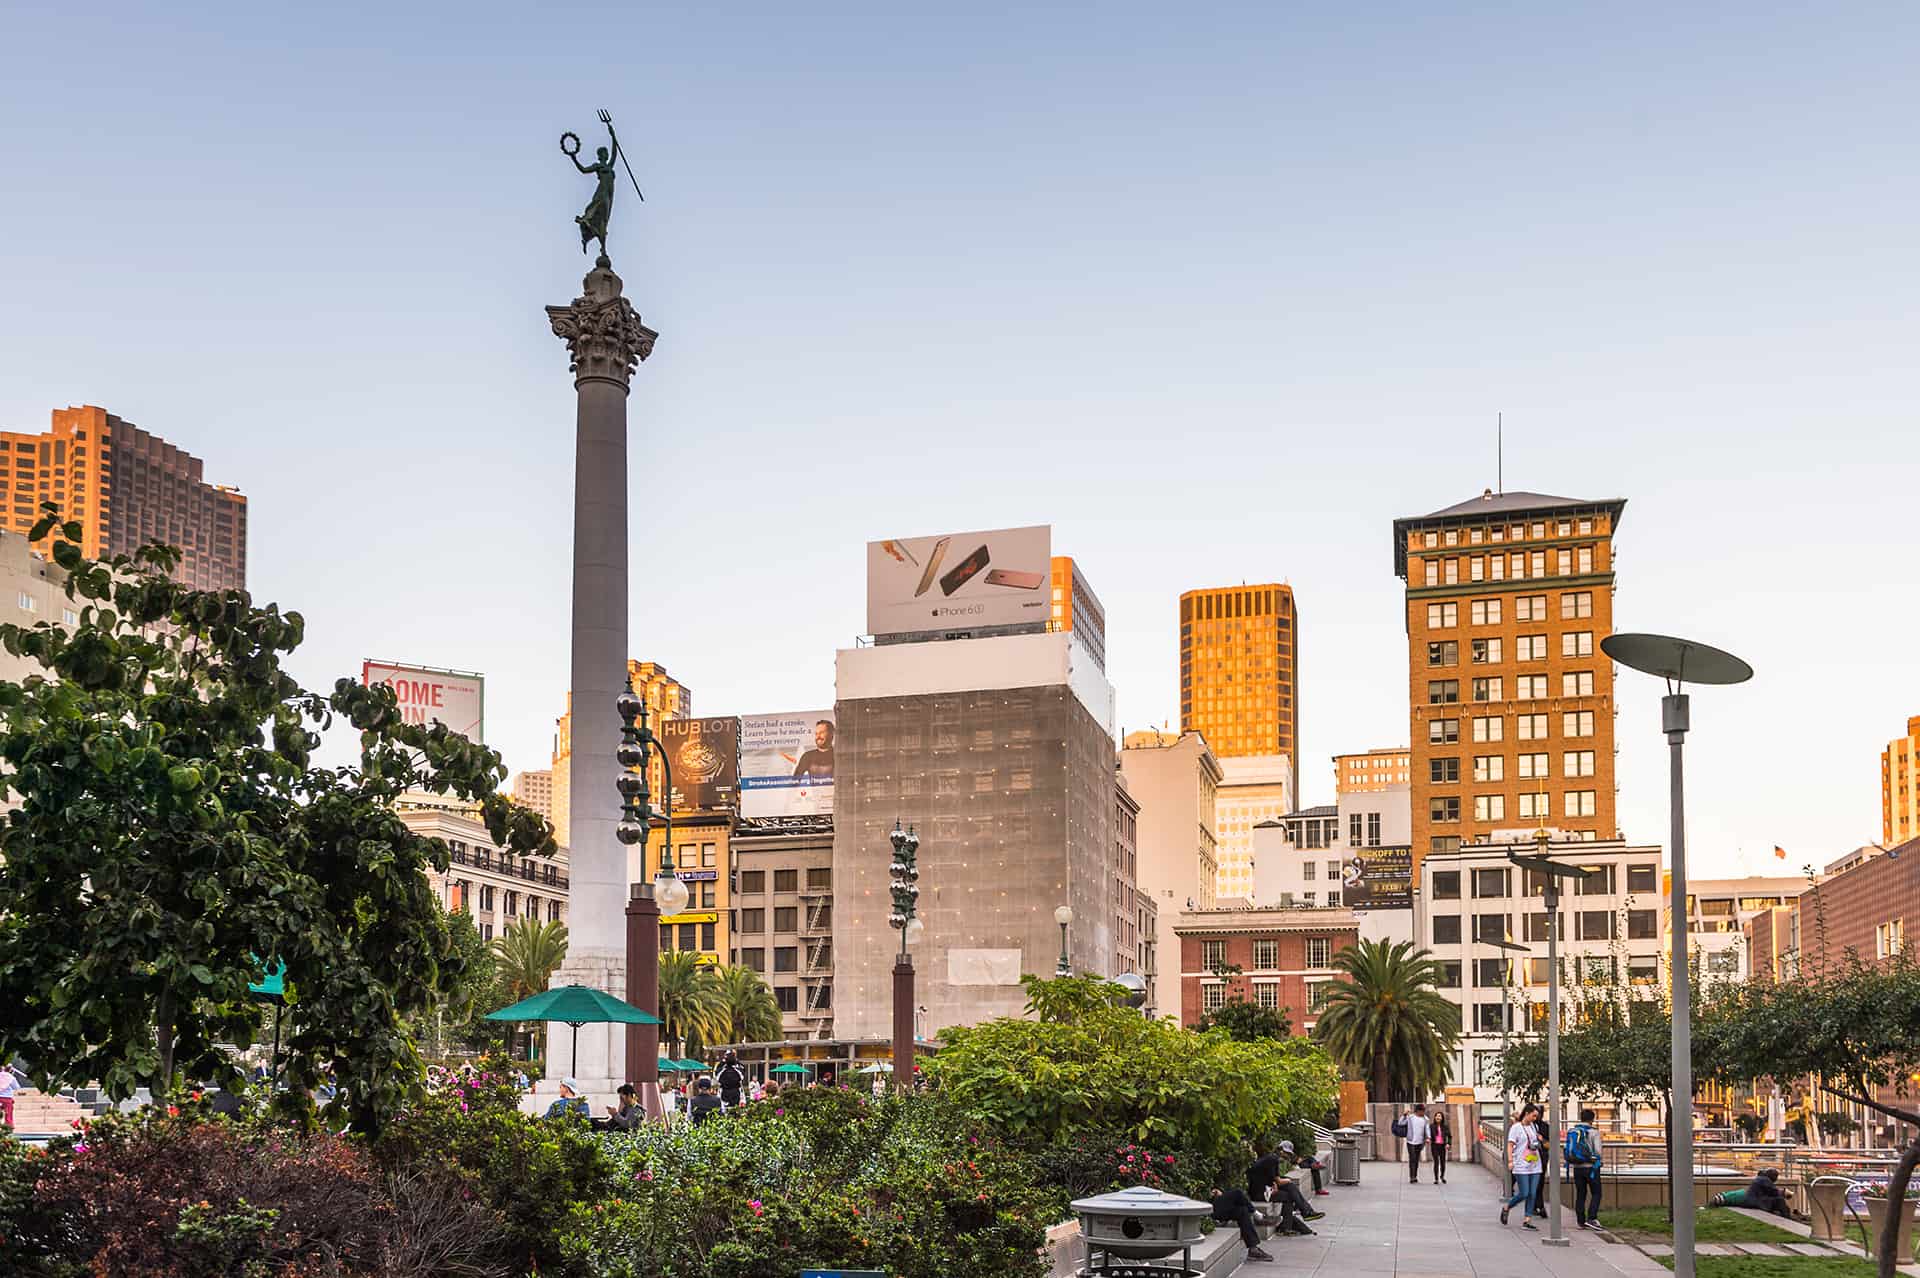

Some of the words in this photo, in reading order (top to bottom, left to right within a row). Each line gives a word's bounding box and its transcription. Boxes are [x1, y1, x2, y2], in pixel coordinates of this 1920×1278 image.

[940, 606, 966, 617] iPhone
[384, 678, 444, 708] OME
[664, 720, 733, 736] HUBLOT
[744, 720, 766, 729] Stefan
[766, 719, 779, 728] had
[744, 729, 764, 738] Learn
[1357, 849, 1393, 857] CKOFF
